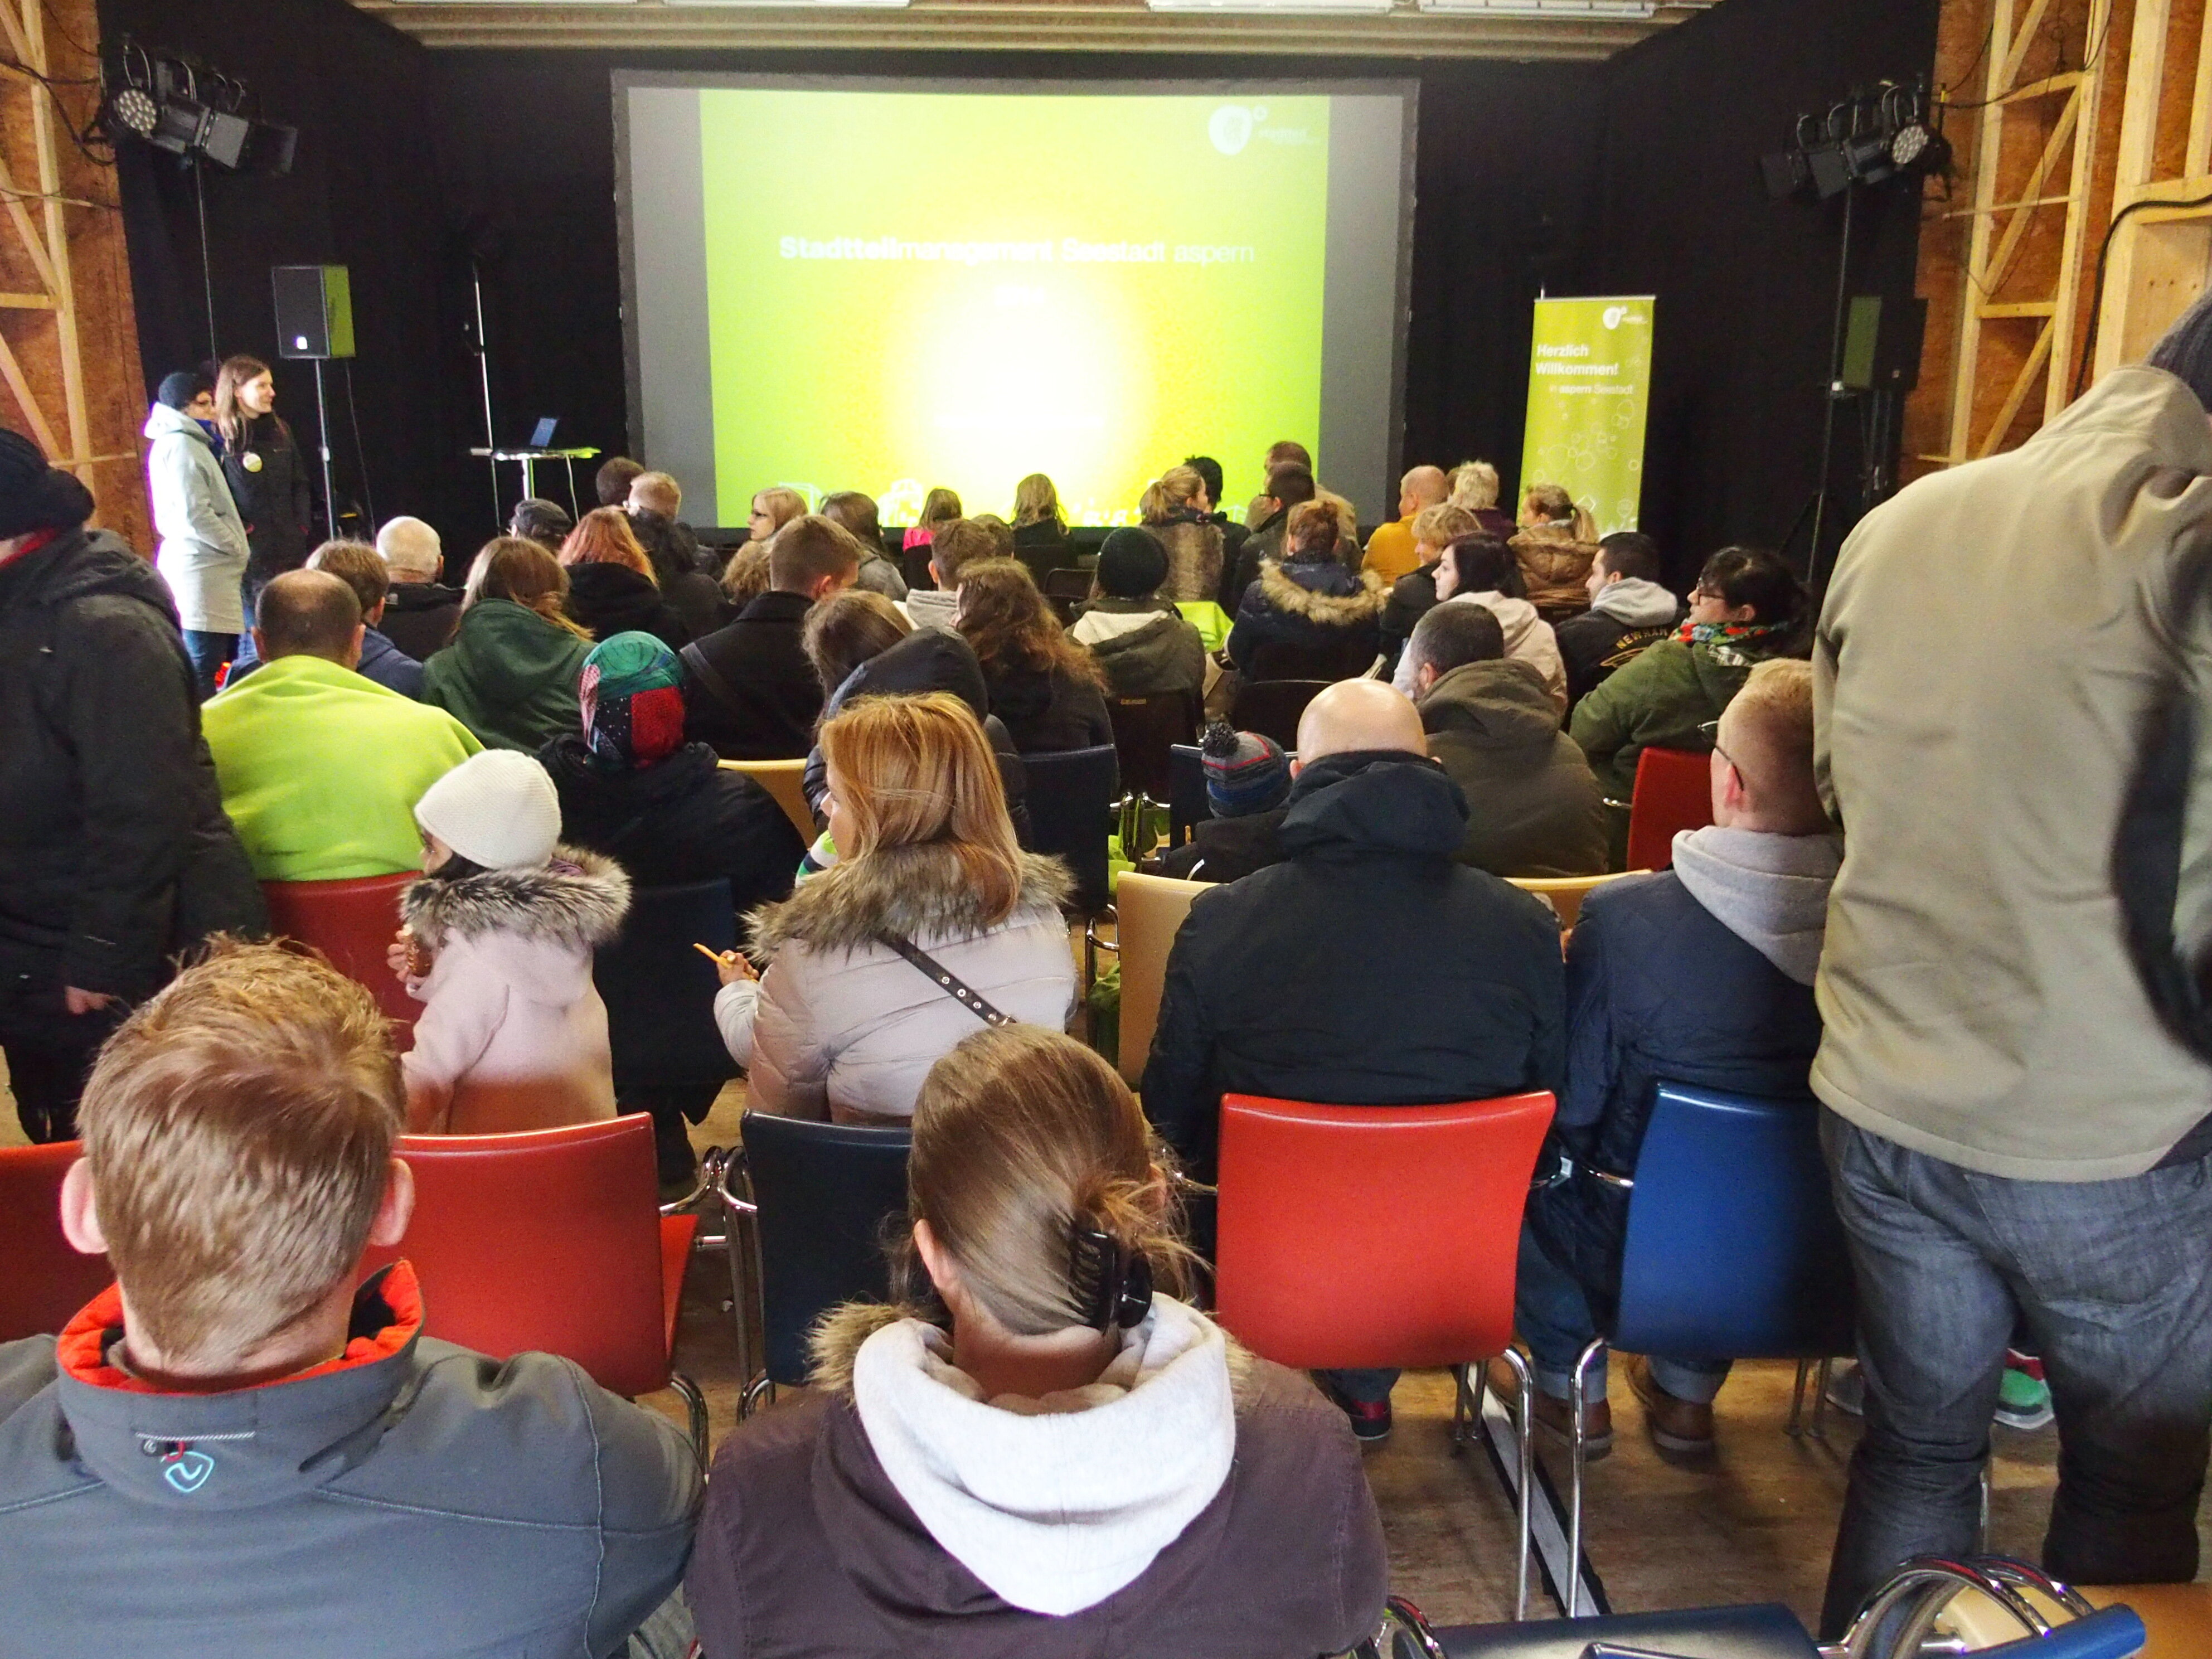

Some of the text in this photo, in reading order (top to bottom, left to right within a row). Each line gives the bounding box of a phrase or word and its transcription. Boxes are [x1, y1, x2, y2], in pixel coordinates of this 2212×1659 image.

[779, 235, 1255, 267] Stadtteilmanagement Seestadt aspern
[1536, 344, 1589, 357] Herzlich
[1535, 362, 1619, 376] Willkommen!
